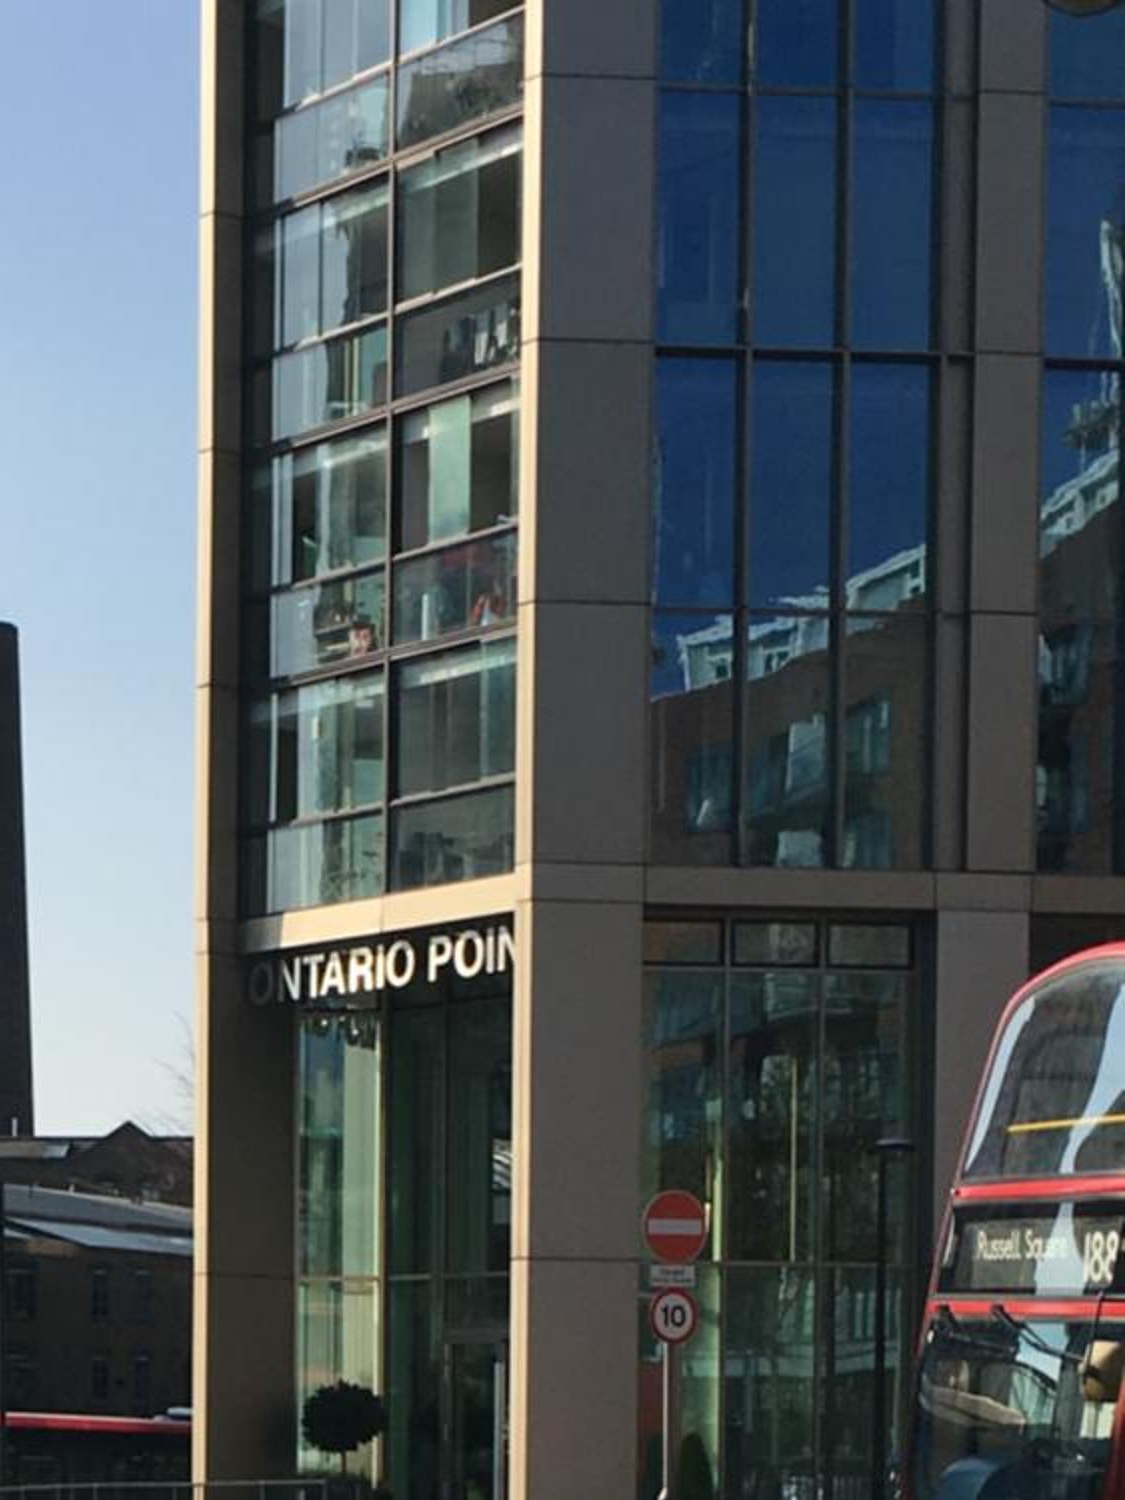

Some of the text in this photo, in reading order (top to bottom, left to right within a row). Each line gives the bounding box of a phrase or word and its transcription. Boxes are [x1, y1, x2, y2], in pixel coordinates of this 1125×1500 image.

[249, 939, 416, 1007] ONTARIO
[974, 1228, 1022, 1261] Russell
[1082, 1229, 1120, 1285] 188
[661, 1304, 687, 1328] 10
